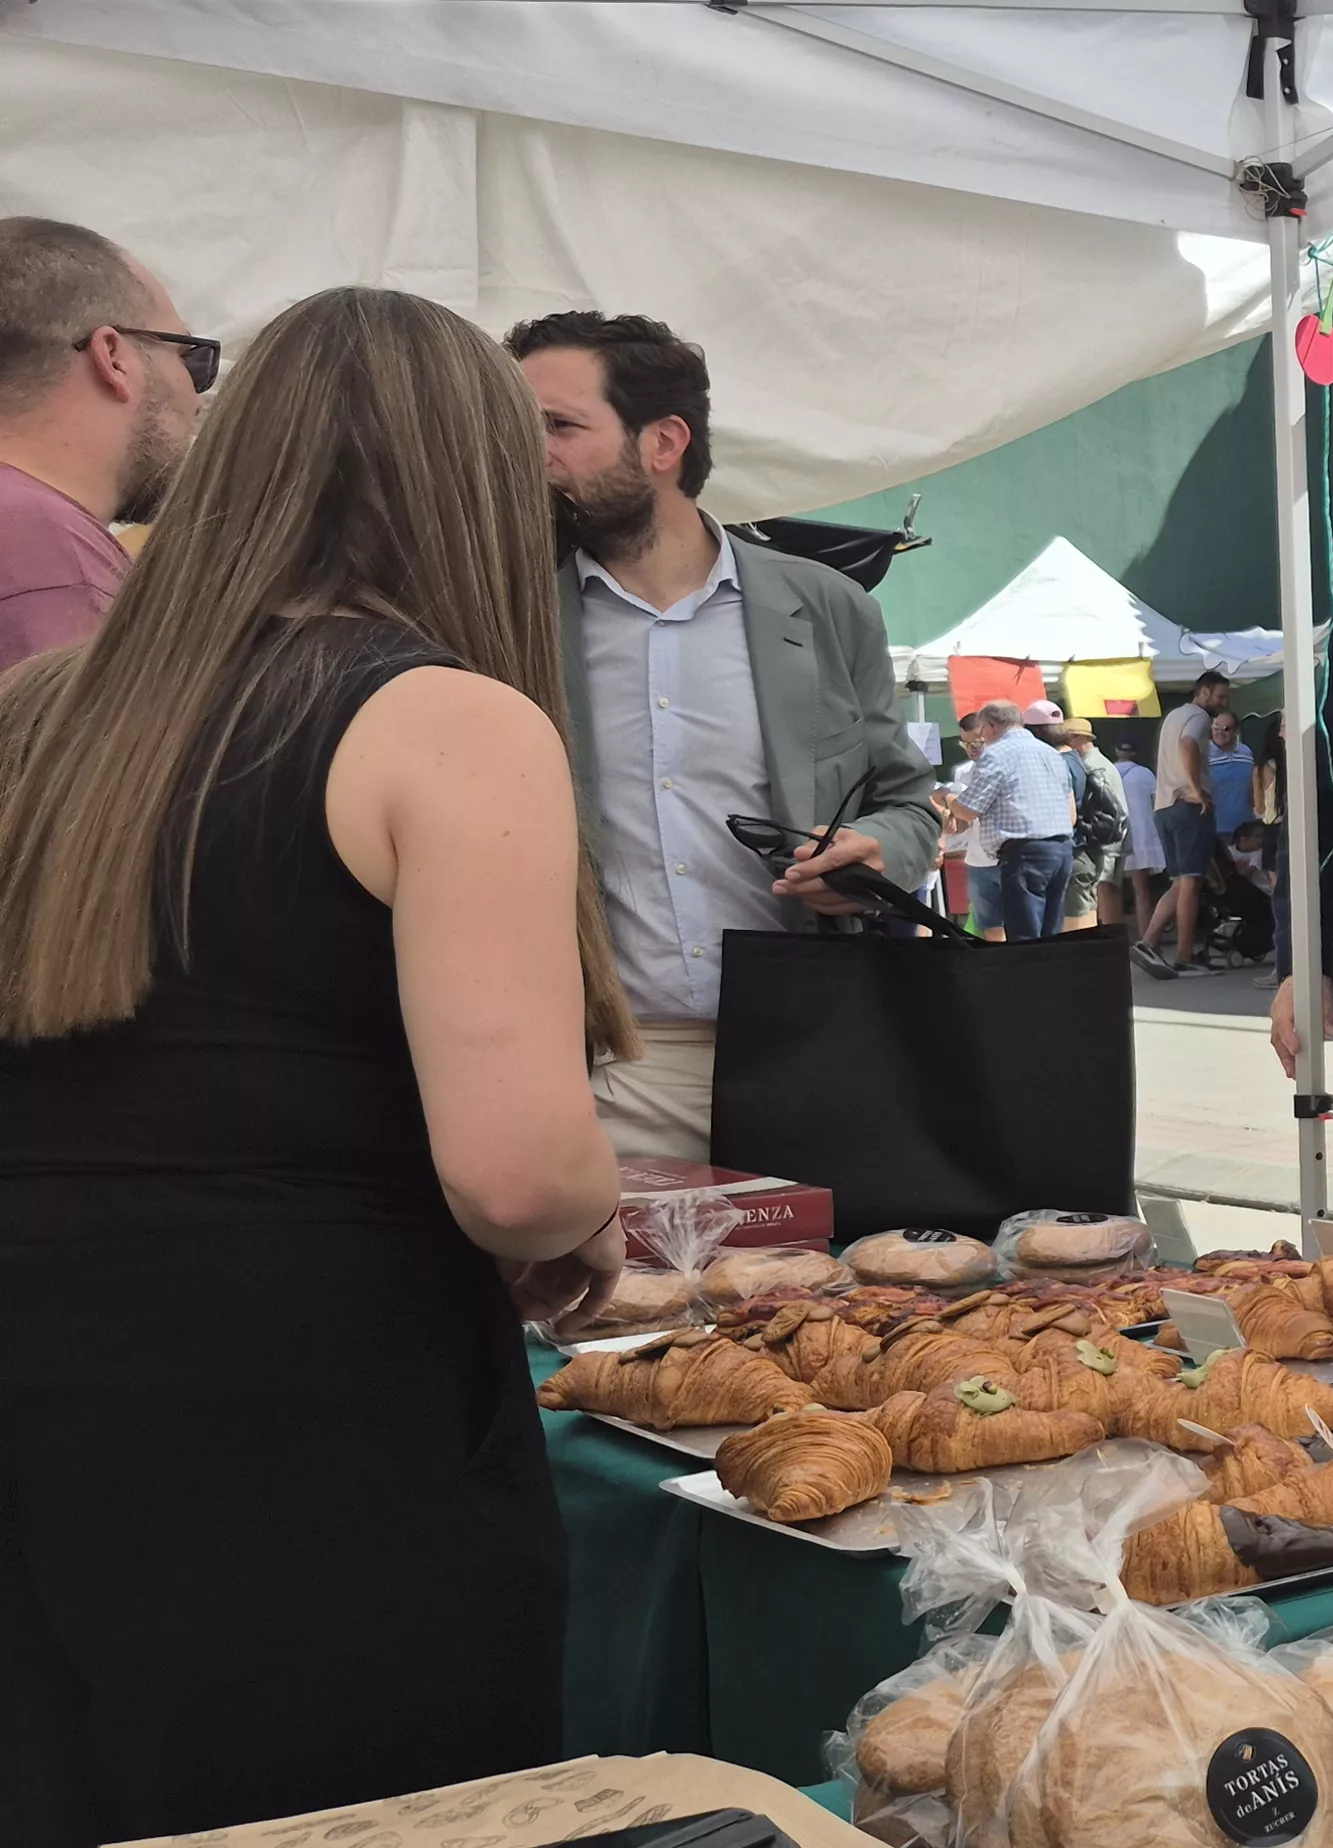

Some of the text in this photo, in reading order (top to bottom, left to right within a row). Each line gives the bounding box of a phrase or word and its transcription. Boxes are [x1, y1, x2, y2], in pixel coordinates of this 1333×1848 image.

[746, 1204, 795, 1223] ENZA
[1224, 1754, 1288, 1796] TORTAS
[1264, 1811, 1296, 1834] ZUCRER
